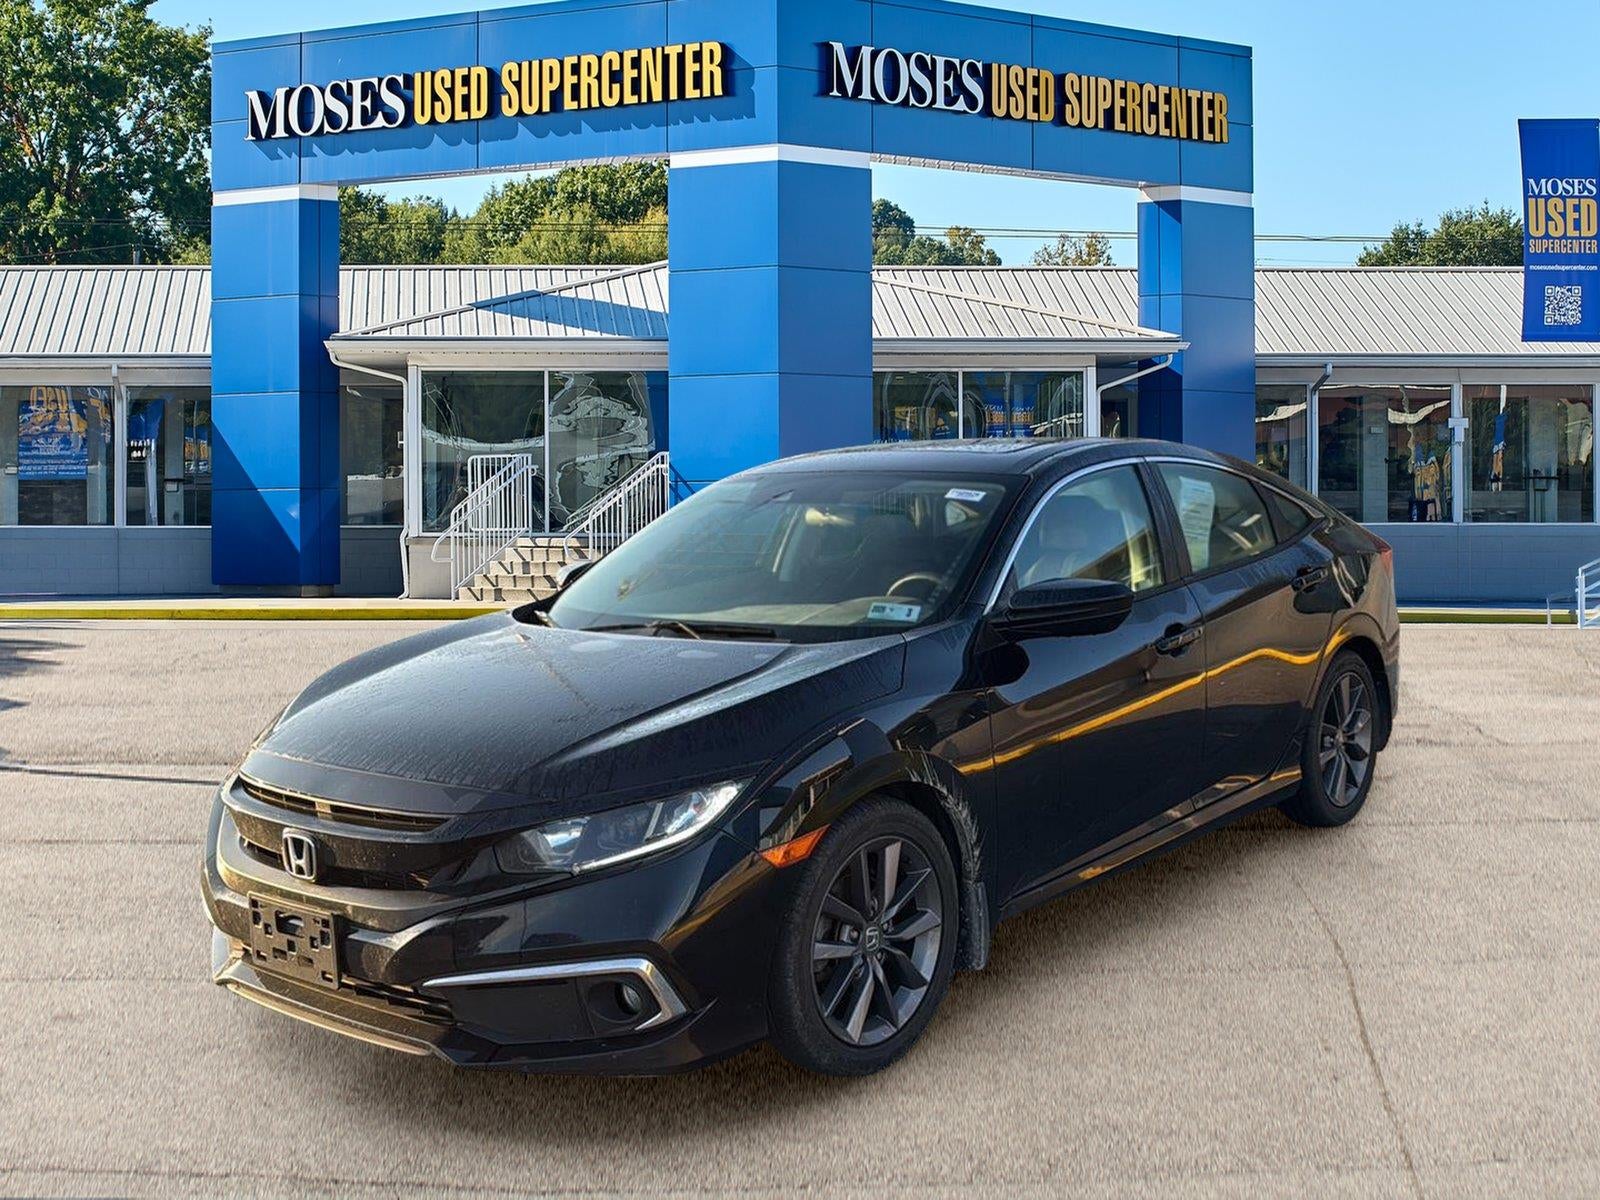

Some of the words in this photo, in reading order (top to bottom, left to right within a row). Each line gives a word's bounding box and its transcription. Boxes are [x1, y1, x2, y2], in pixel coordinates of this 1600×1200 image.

[244, 74, 406, 141] MOSES
[413, 66, 488, 125] USED
[500, 41, 723, 118] SUPERCENTER
[828, 41, 983, 114] MOSES
[992, 62, 1055, 122] USED
[1065, 72, 1229, 144] SUPERCENTER
[1527, 178, 1596, 196] MOSES
[1528, 198, 1597, 237] USED
[1529, 239, 1597, 254] SUPERCENTER
